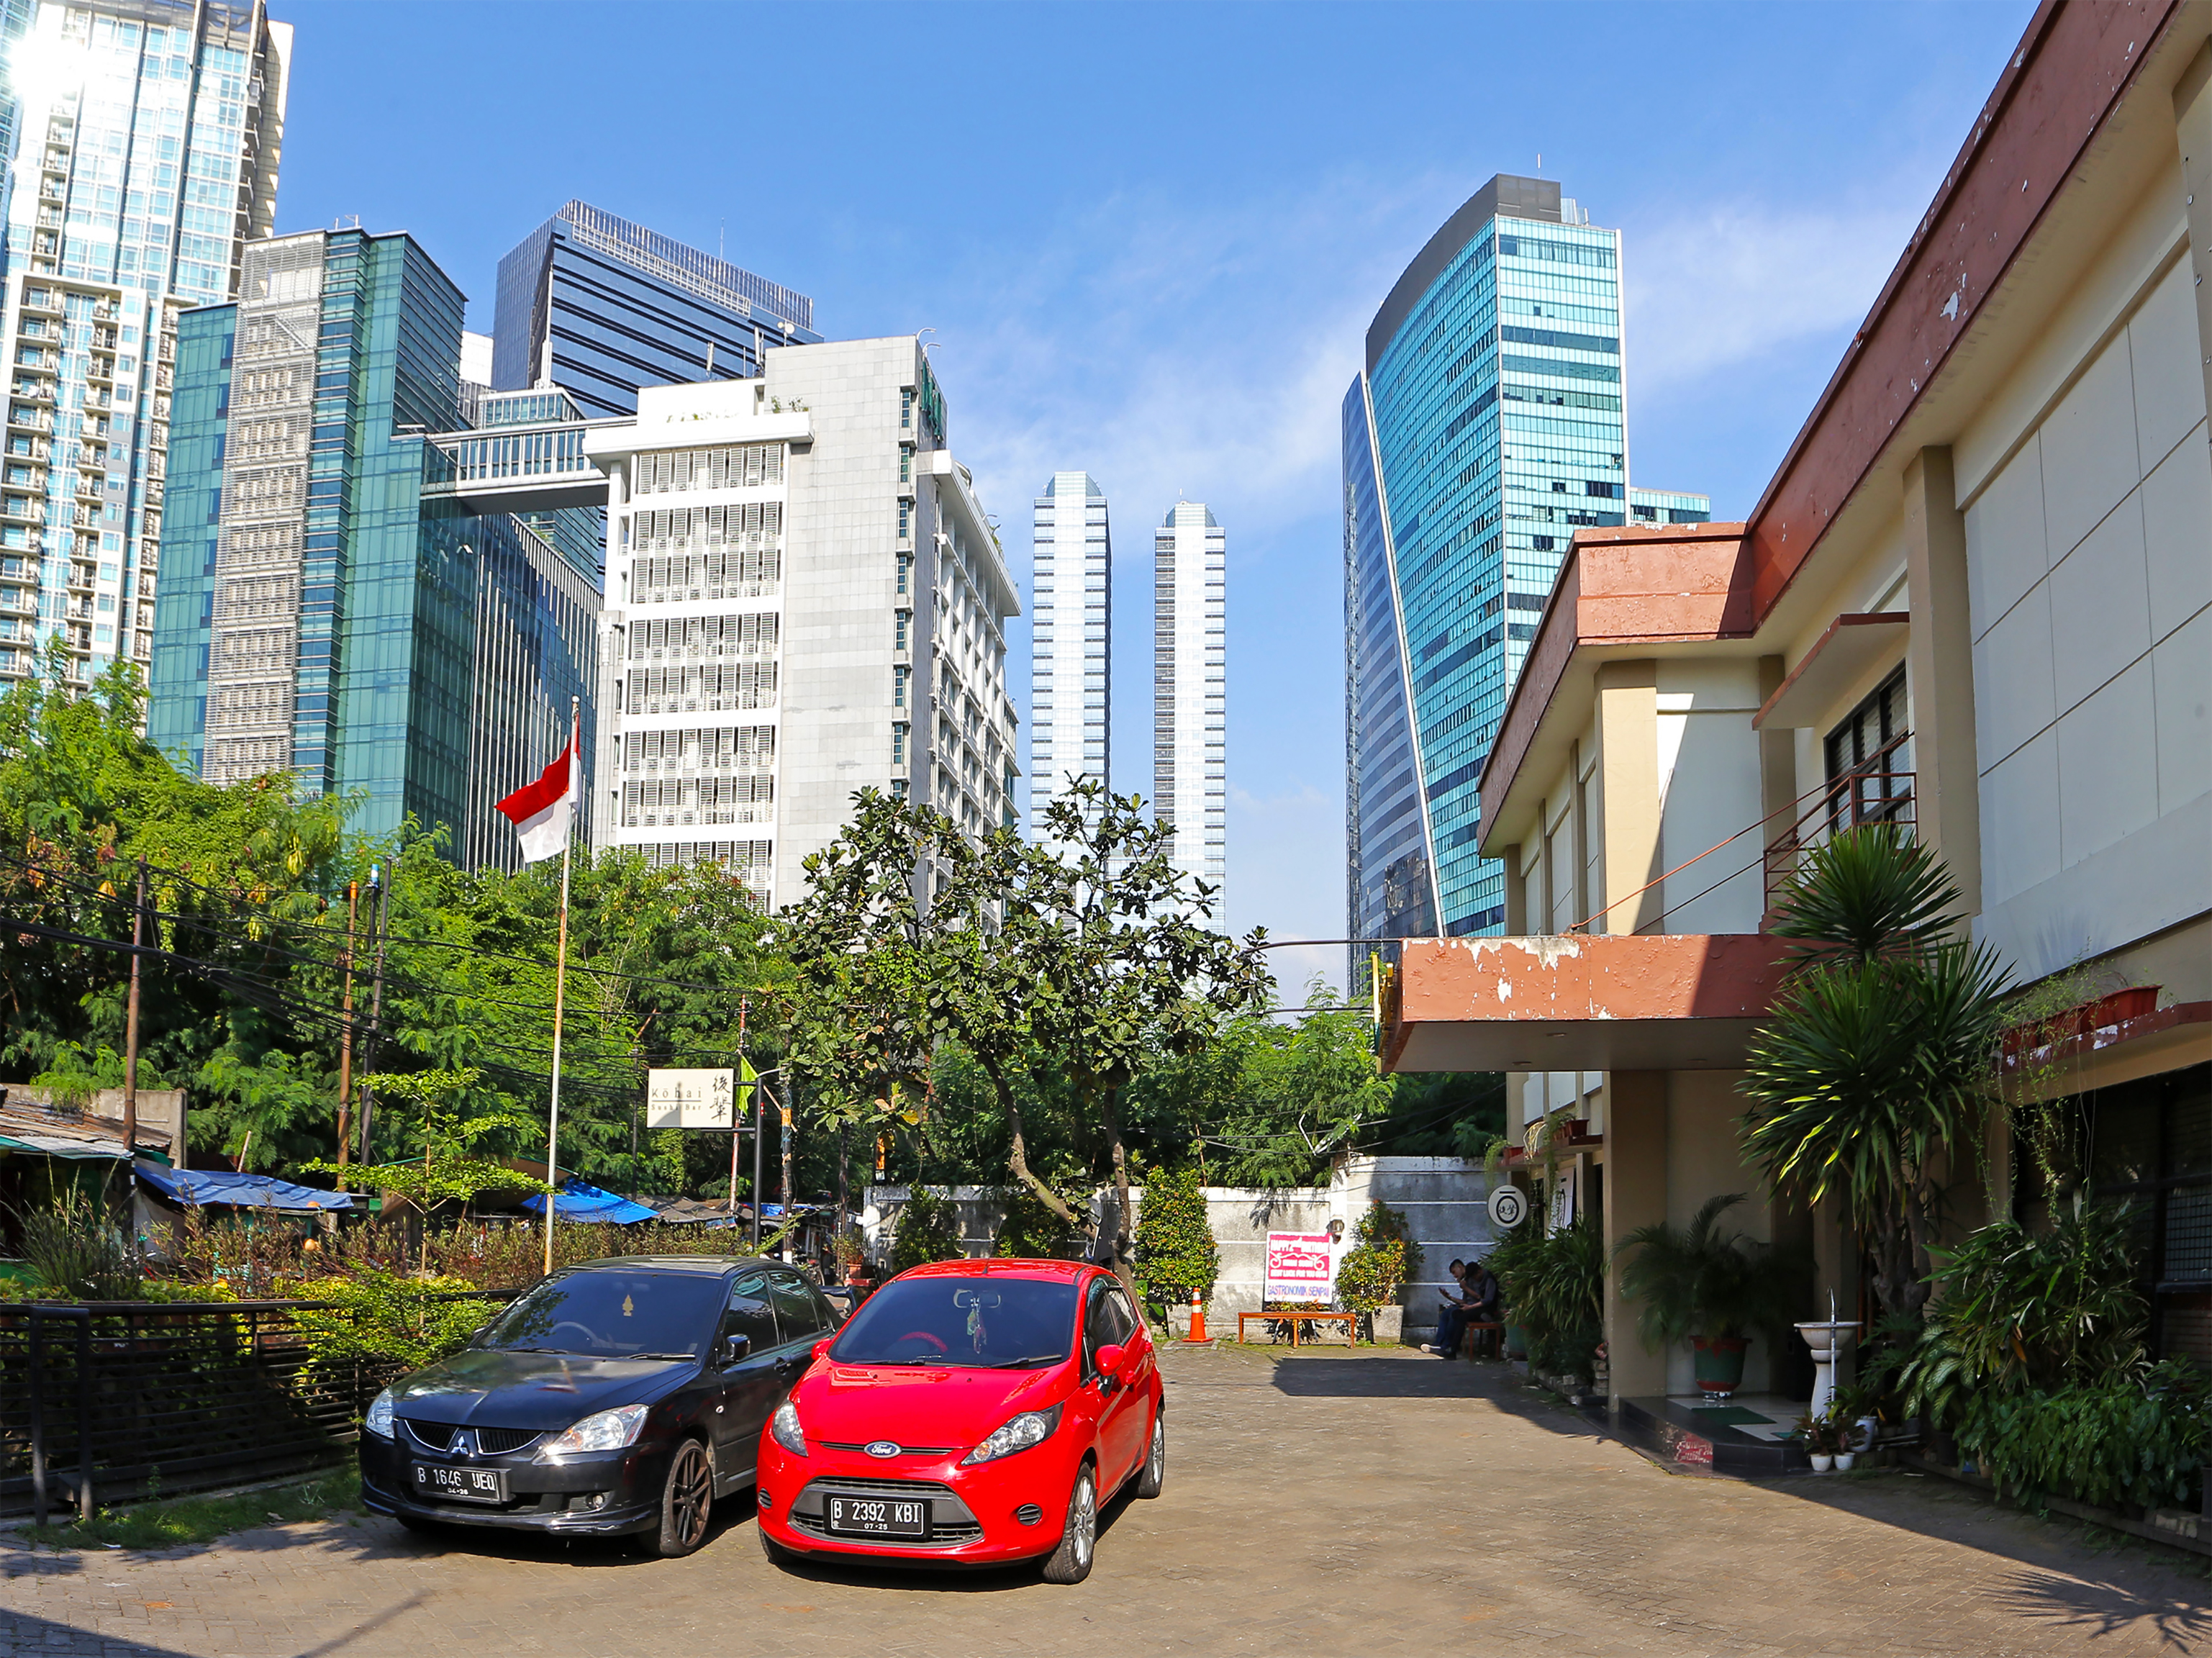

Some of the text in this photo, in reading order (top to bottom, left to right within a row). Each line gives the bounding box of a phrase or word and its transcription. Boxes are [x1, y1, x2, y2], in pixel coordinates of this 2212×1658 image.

[871, 1444, 892, 1455] Ford
[417, 1467, 426, 1482] B
[433, 1469, 461, 1487] 1646
[833, 1500, 920, 1523] B 2392 KBI
